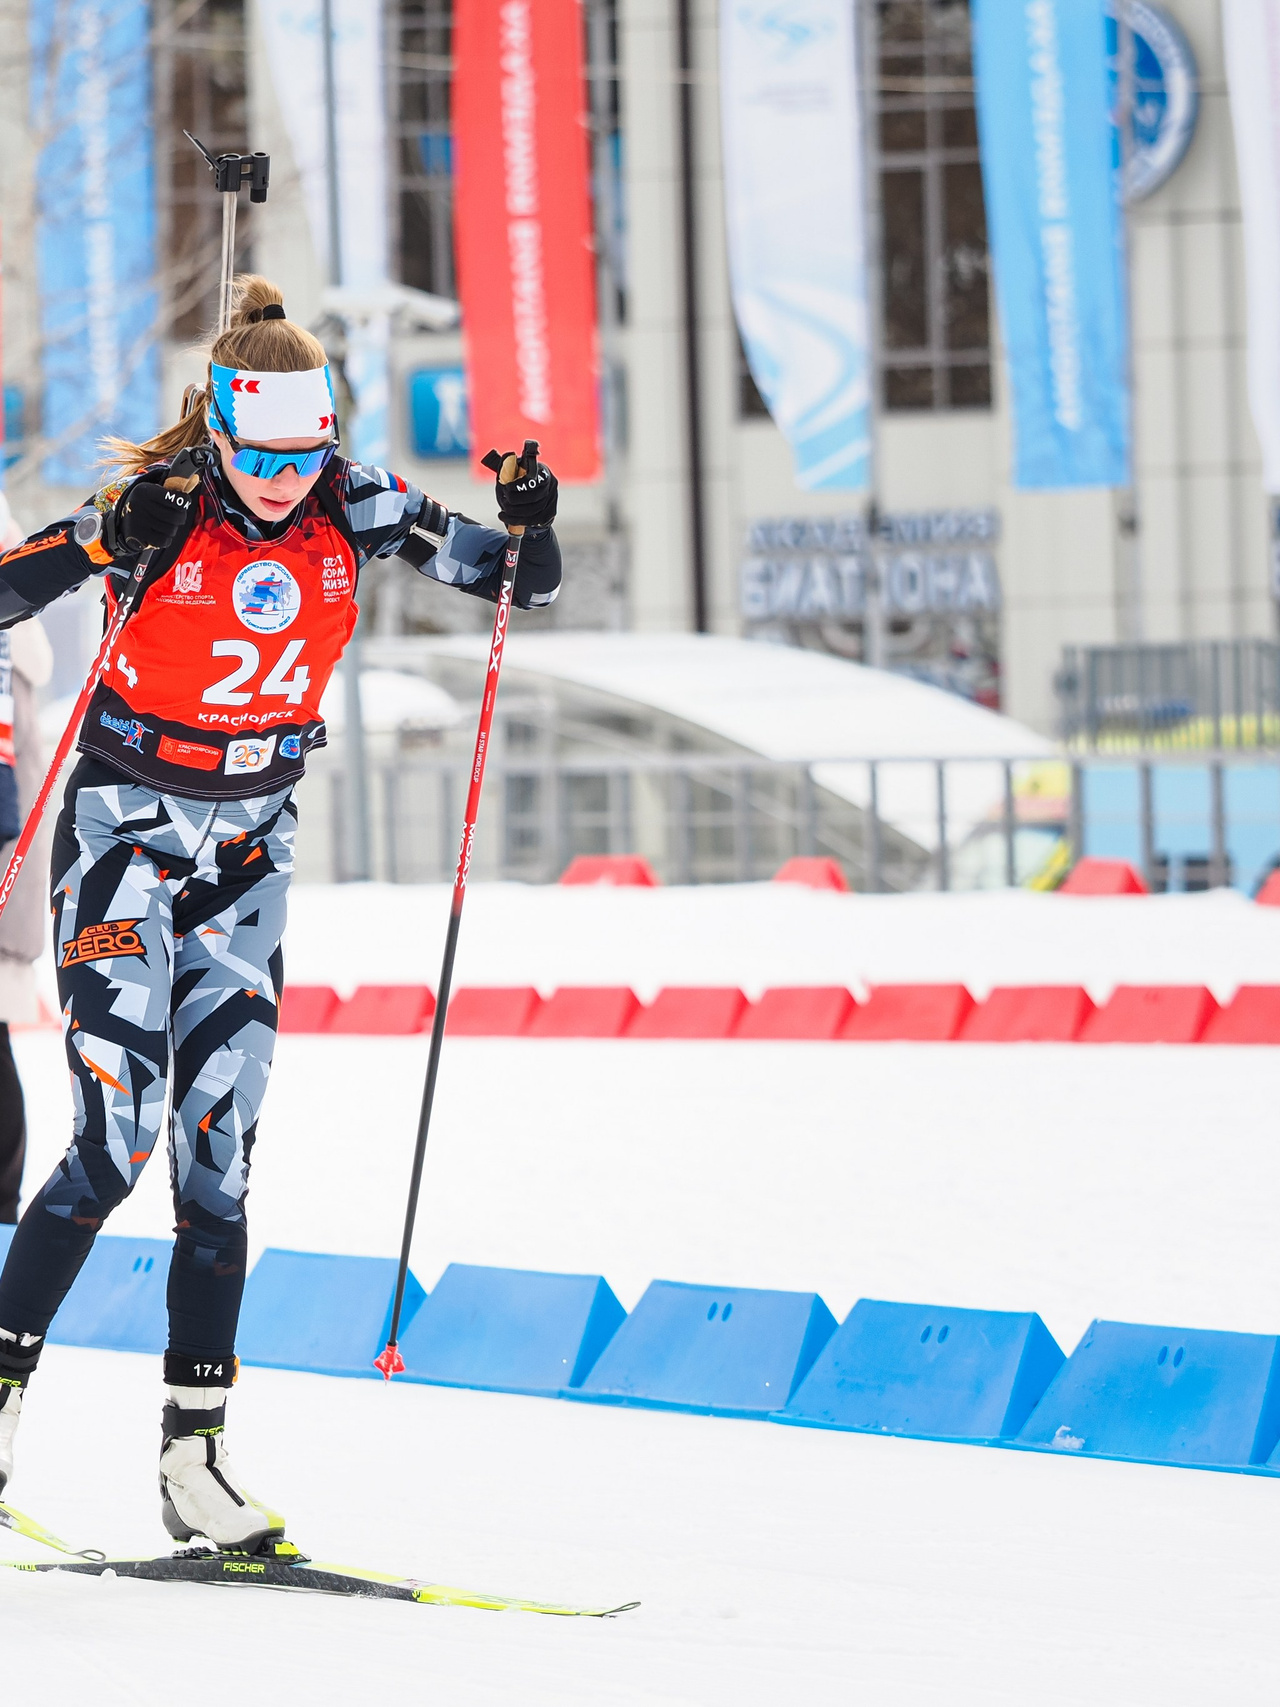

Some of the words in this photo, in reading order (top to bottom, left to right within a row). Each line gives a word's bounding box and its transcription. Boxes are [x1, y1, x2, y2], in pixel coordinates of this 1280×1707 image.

[516, 469, 550, 493] MOAX
[488, 580, 512, 673] MOAX
[201, 639, 311, 706] 24
[197, 709, 296, 727] КРАСНОЯРСК
[178, 743, 219, 756] КРАСНОЯРСКИЙ
[86, 923, 120, 935] CLUB
[62, 931, 141, 968] ZERO
[193, 1363, 223, 1377] 174
[223, 1562, 265, 1574] FISCHER
